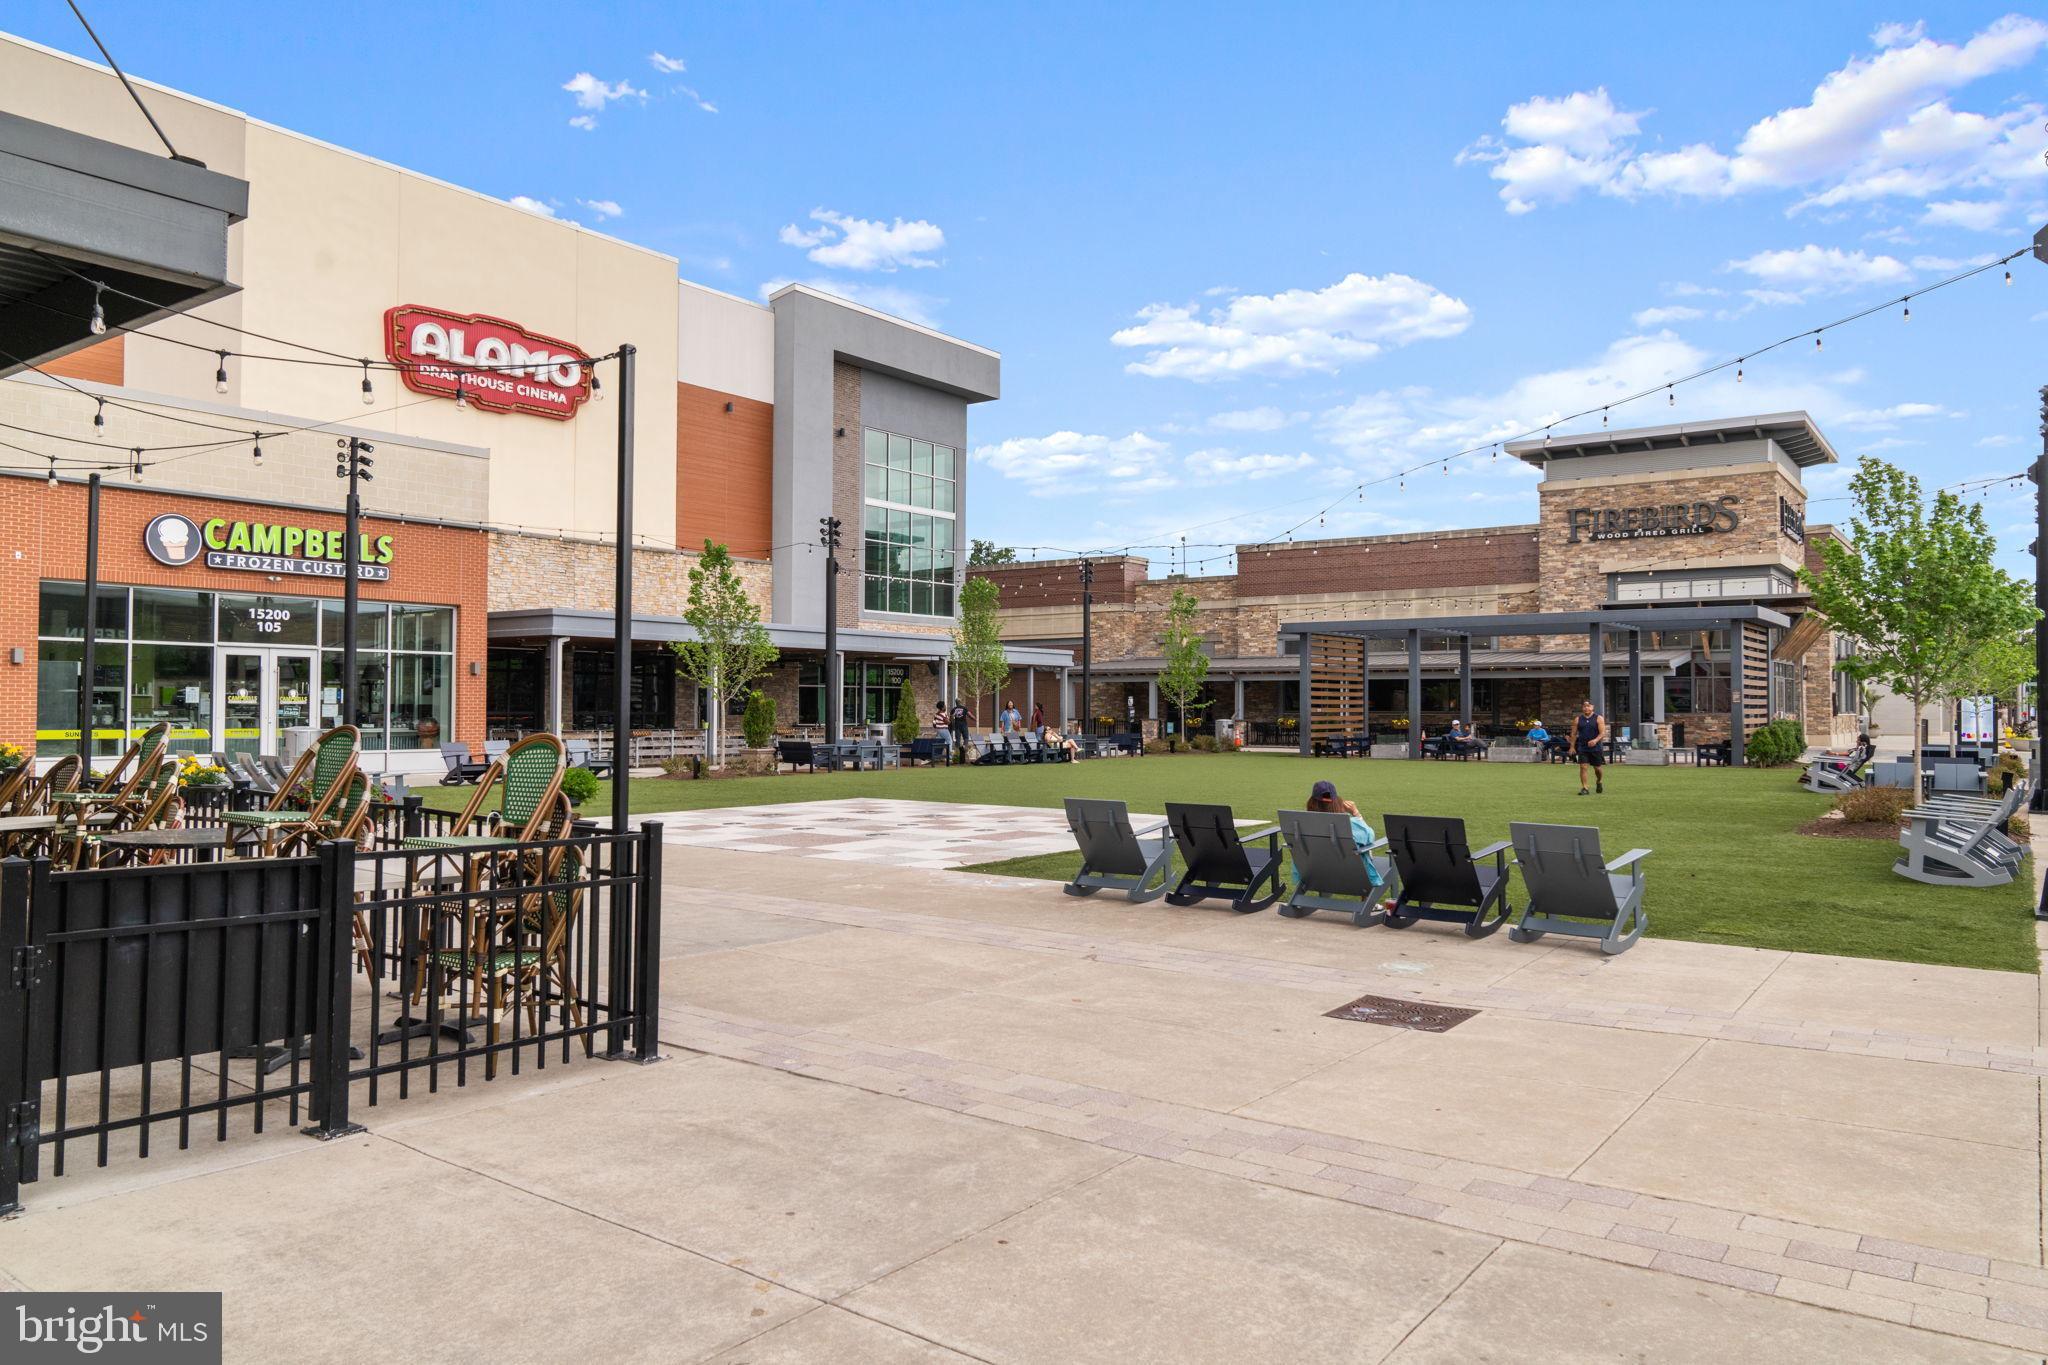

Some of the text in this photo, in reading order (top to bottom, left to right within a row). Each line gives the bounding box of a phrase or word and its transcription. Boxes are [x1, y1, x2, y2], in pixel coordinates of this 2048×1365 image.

[411, 322, 582, 388] ALAMO
[516, 384, 568, 405] CINEMA
[1566, 494, 1738, 543] FIREBIRDS
[203, 517, 394, 564] CAMPBELS
[1597, 525, 1704, 540] WOOD FIRED GRILL
[226, 554, 375, 578] FROZEN CUSTRD
[249, 608, 291, 620] 15200
[257, 621, 282, 632] 105
